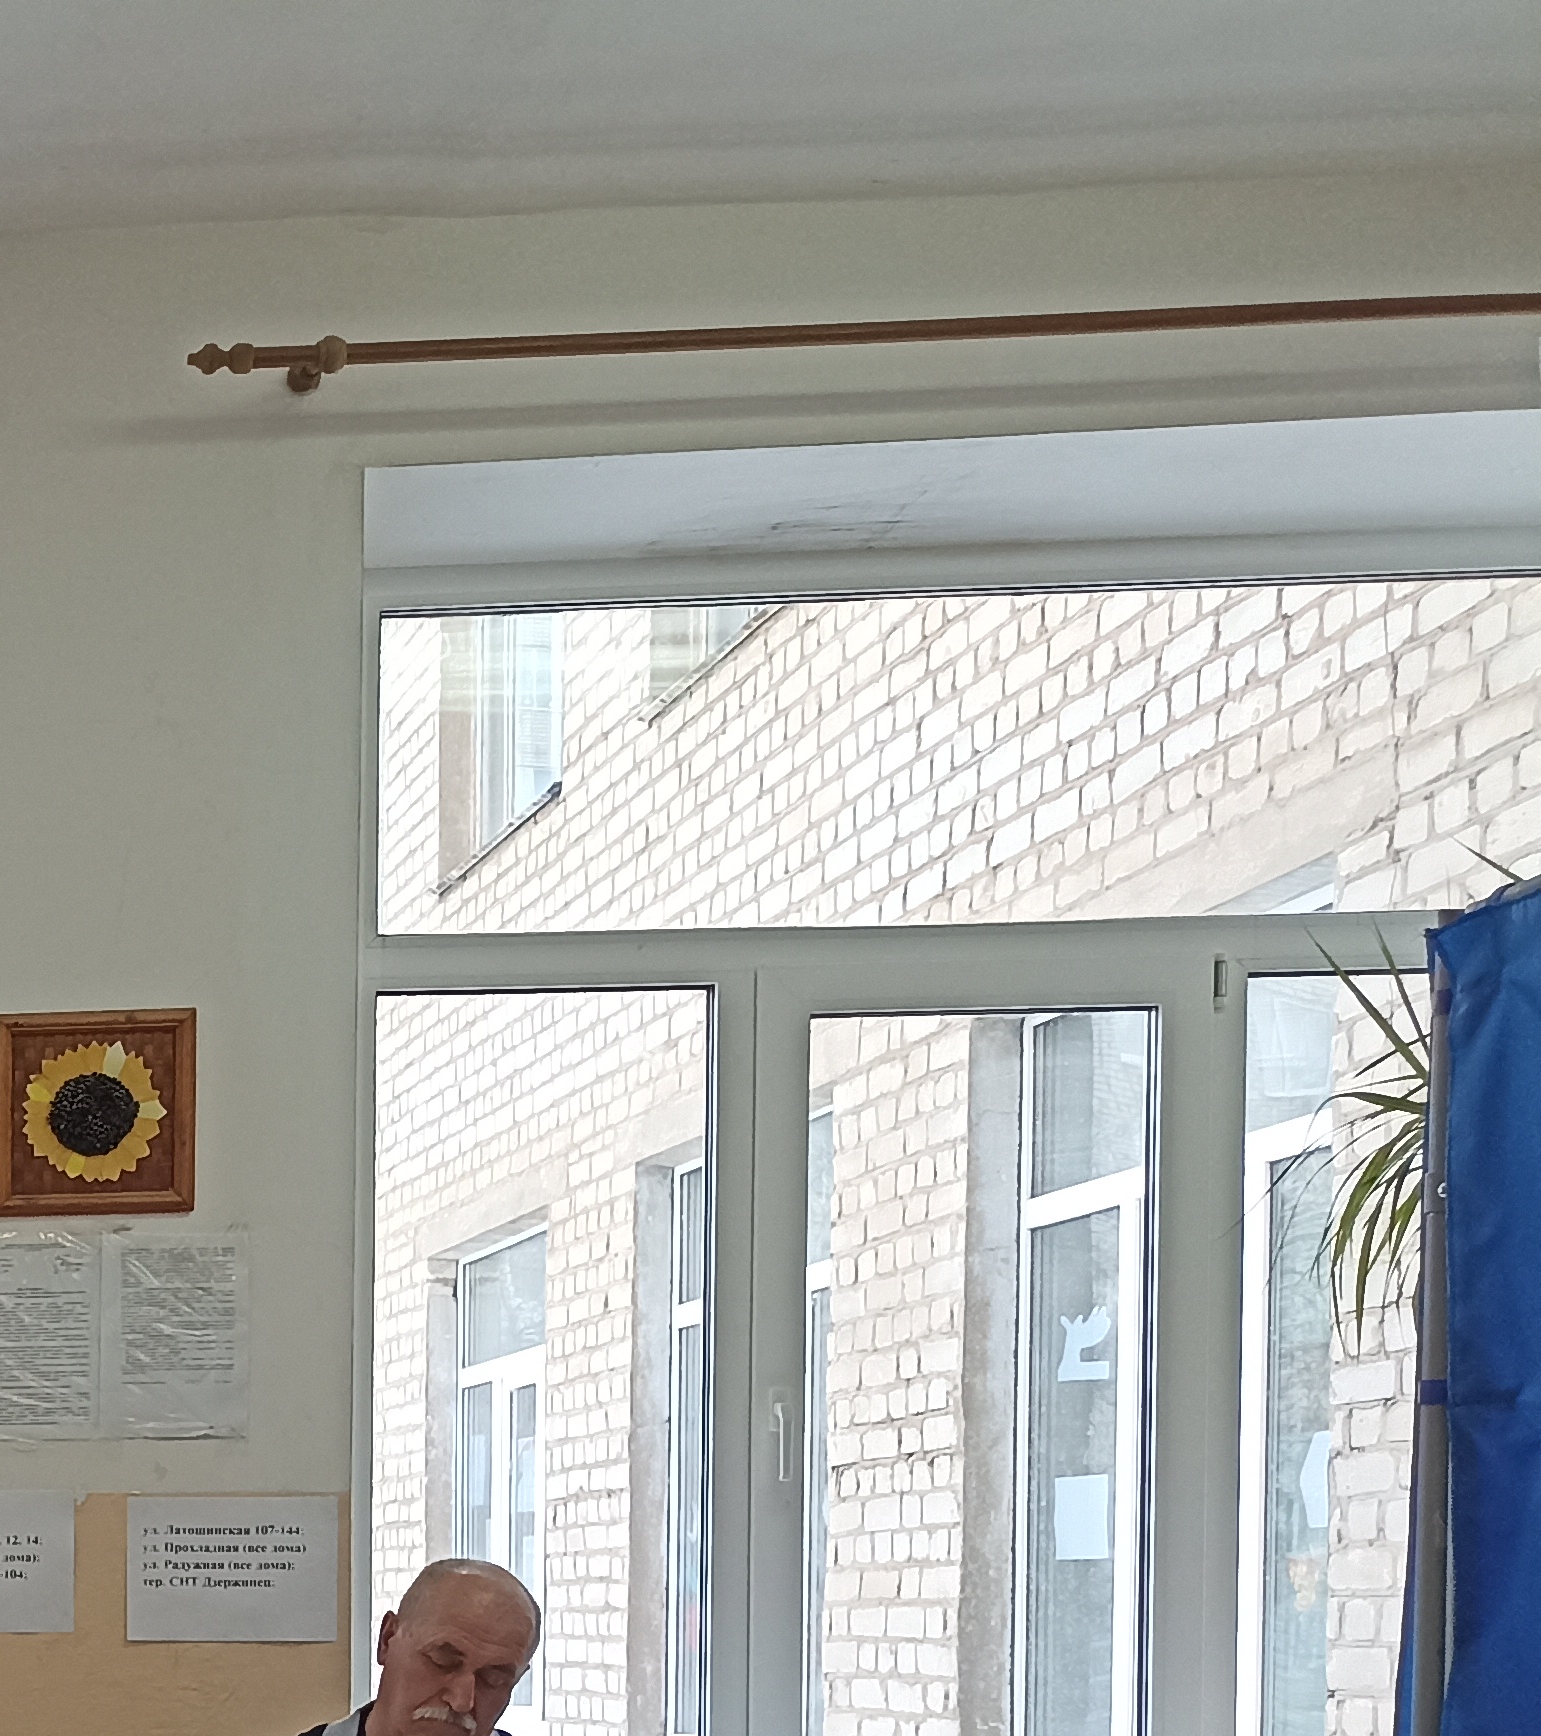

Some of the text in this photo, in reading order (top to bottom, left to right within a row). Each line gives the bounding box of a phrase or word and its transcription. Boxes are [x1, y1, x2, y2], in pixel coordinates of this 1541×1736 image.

[143, 1528, 160, 1537] ул.
[163, 1525, 251, 1536] Латошинская
[142, 1546, 160, 1555] ул.
[164, 1543, 239, 1556] Прохладная
[243, 1544, 267, 1554] (все
[142, 1562, 160, 1573] ул.
[164, 1560, 224, 1572] Радужная
[228, 1561, 253, 1571] (все
[169, 1577, 197, 1587] СНТ
